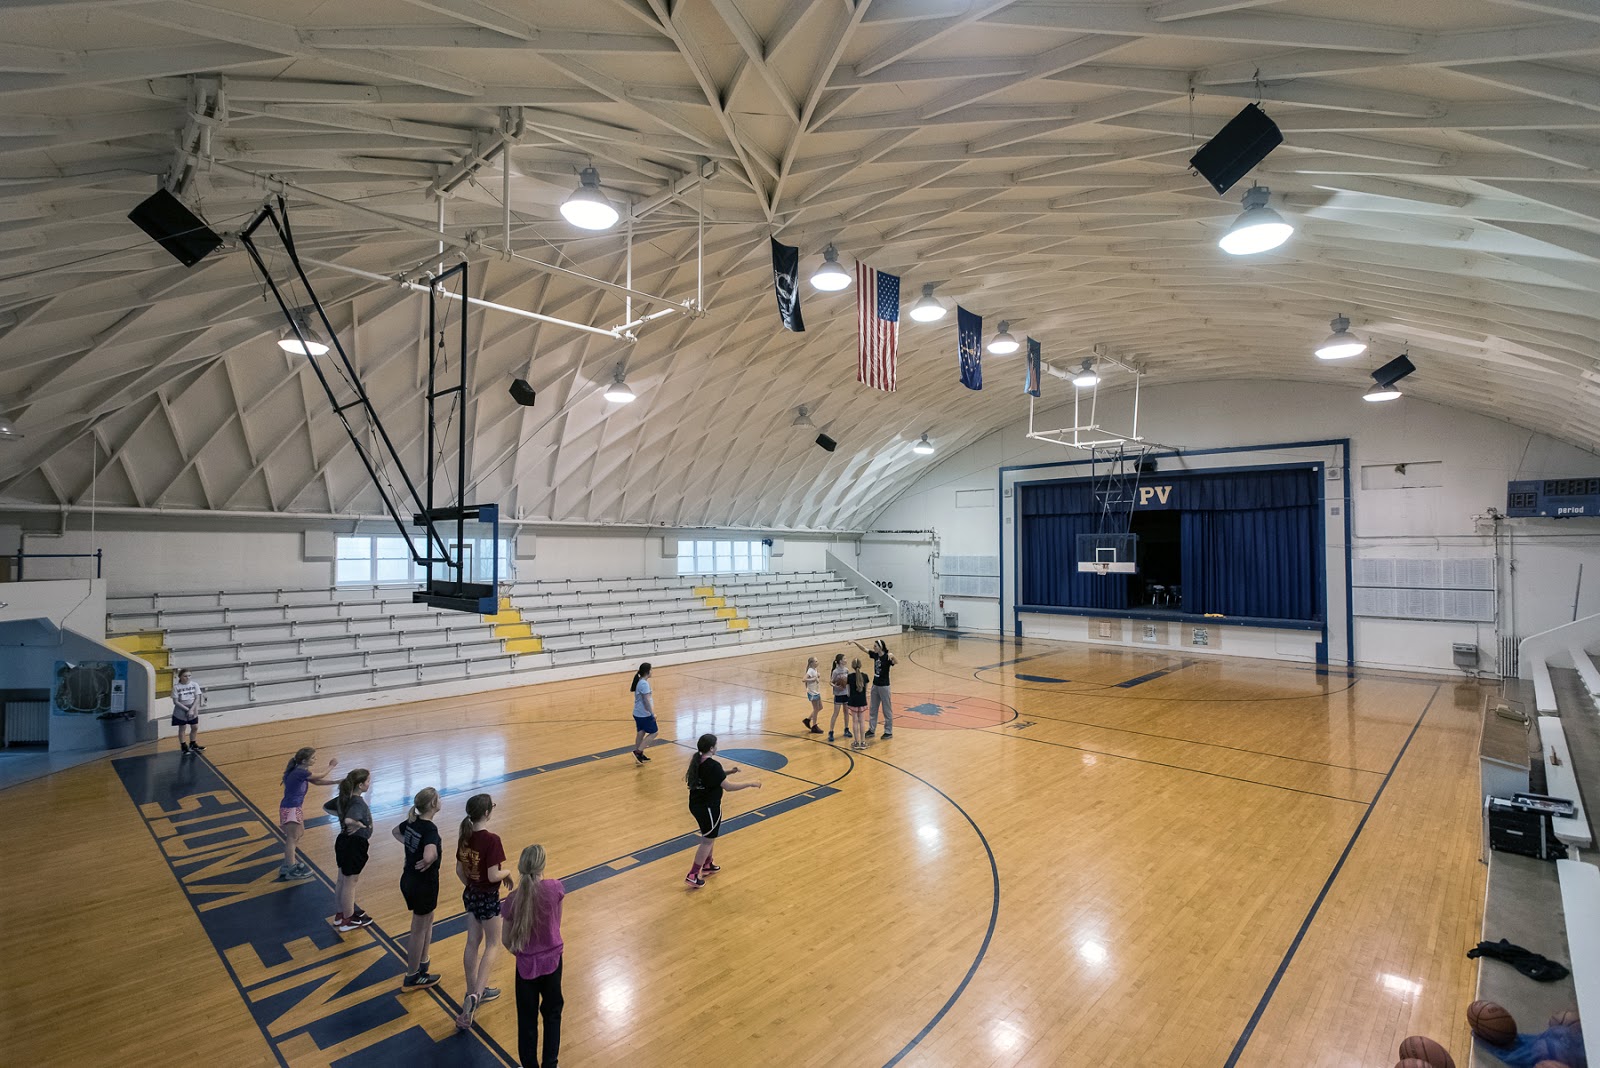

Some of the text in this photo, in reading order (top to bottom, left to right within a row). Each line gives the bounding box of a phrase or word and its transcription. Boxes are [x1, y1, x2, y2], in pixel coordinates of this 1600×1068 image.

[1139, 485, 1172, 505] PV
[1557, 506, 1584, 515] period
[139, 790, 317, 913] KNOTS
